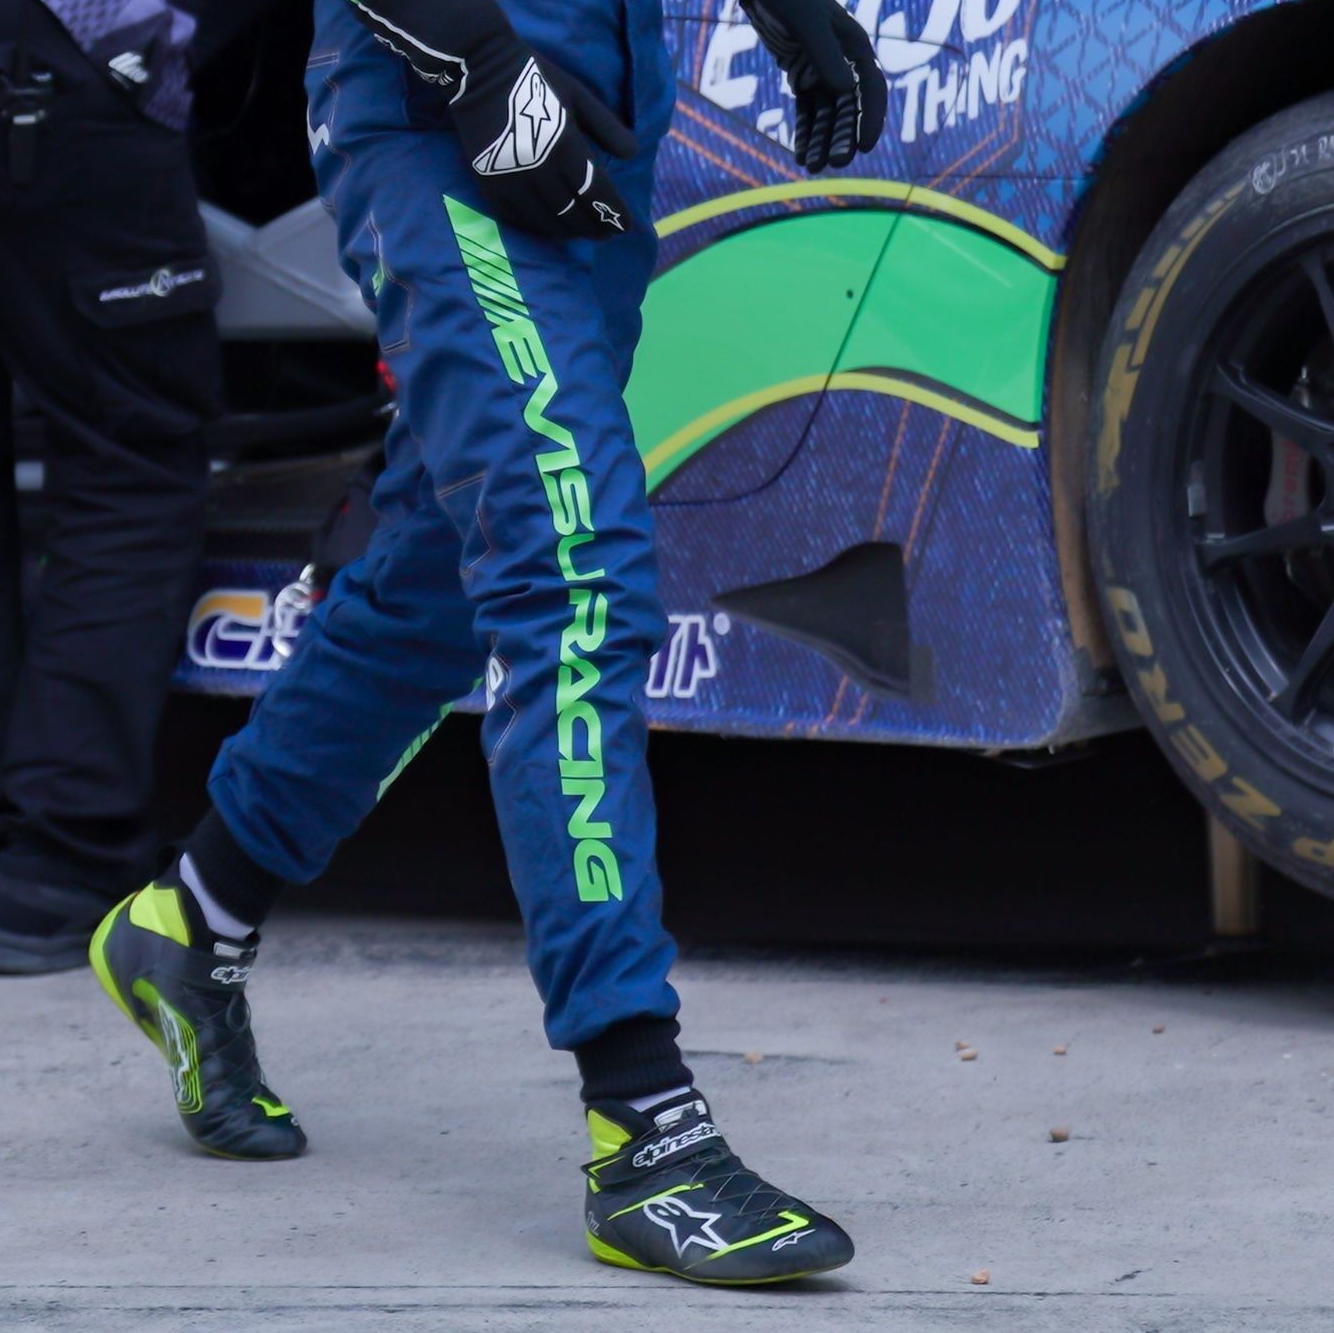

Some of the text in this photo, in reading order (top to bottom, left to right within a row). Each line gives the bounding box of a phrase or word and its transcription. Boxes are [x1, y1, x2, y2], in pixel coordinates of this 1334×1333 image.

[483, 312, 607, 582] EVISU
[556, 588, 624, 903] RACING
[1107, 585, 1283, 832] ZERO
